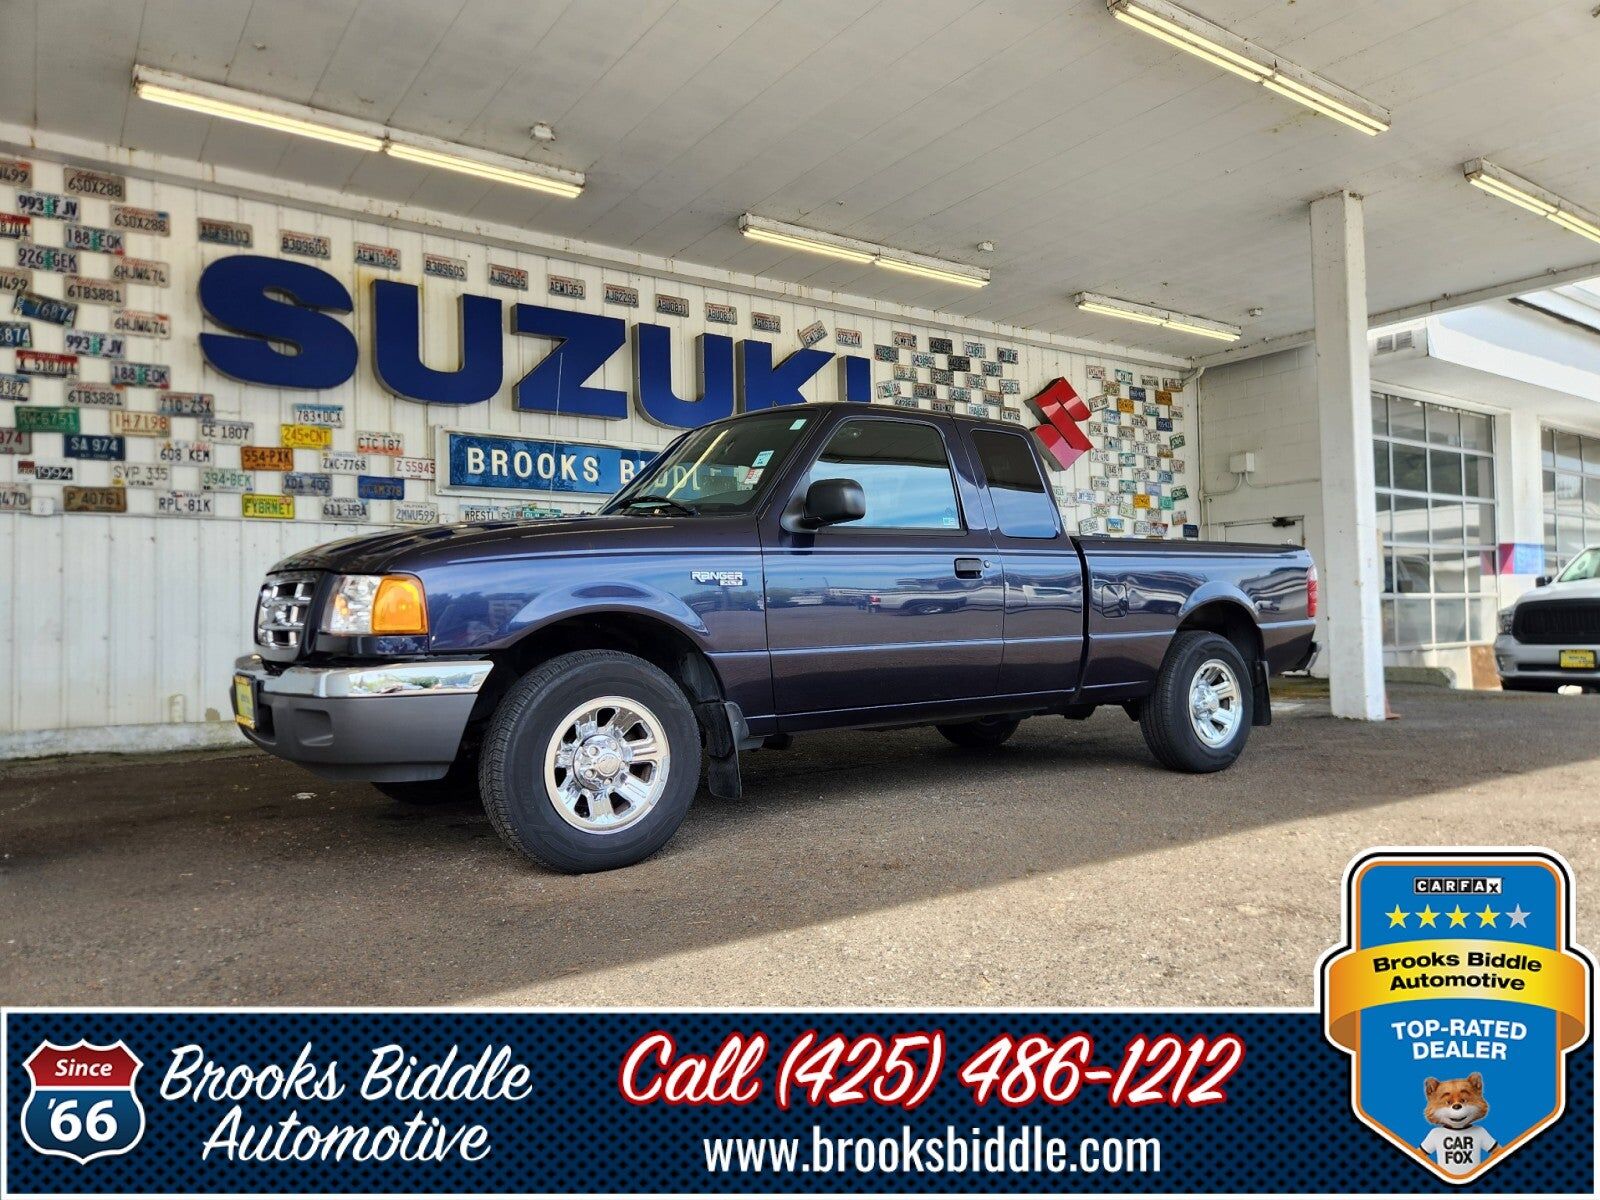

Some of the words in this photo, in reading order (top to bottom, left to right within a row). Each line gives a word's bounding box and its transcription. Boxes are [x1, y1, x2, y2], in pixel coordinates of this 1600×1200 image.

[197, 253, 871, 428] SUZUKI
[467, 447, 599, 483] BROOKS
[691, 571, 743, 582] RANGER
